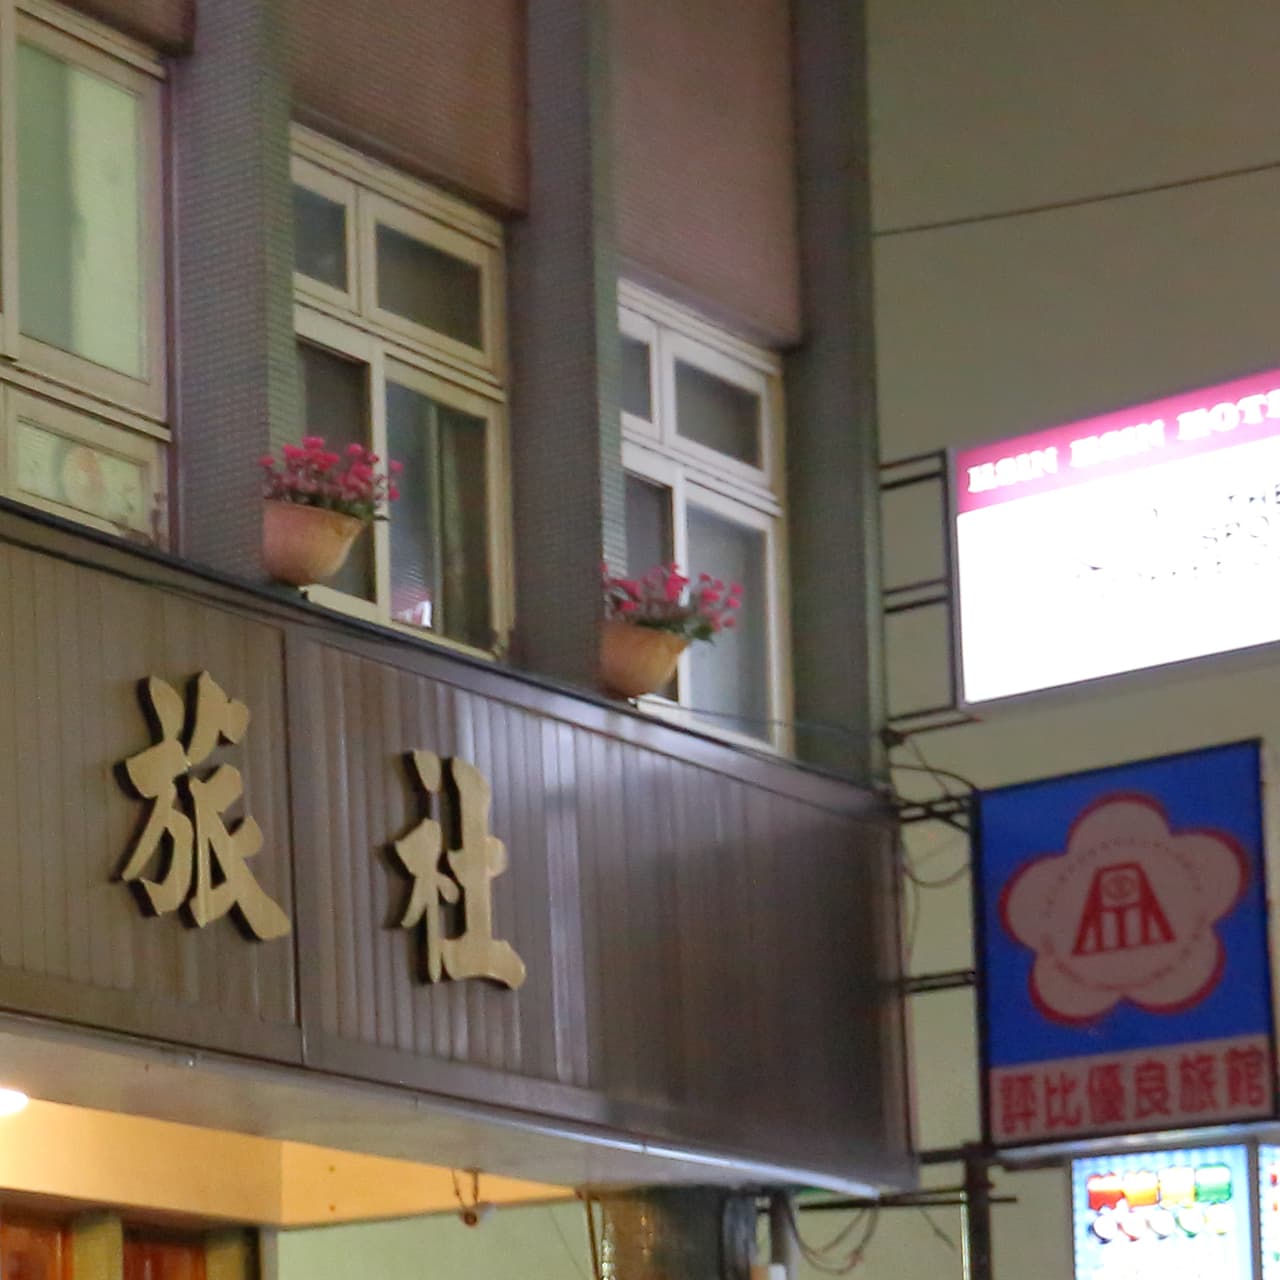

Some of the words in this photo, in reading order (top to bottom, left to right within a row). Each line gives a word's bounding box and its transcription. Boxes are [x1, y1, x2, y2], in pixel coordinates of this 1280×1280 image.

[1000, 1045, 1268, 1135] 評比優良旅館
